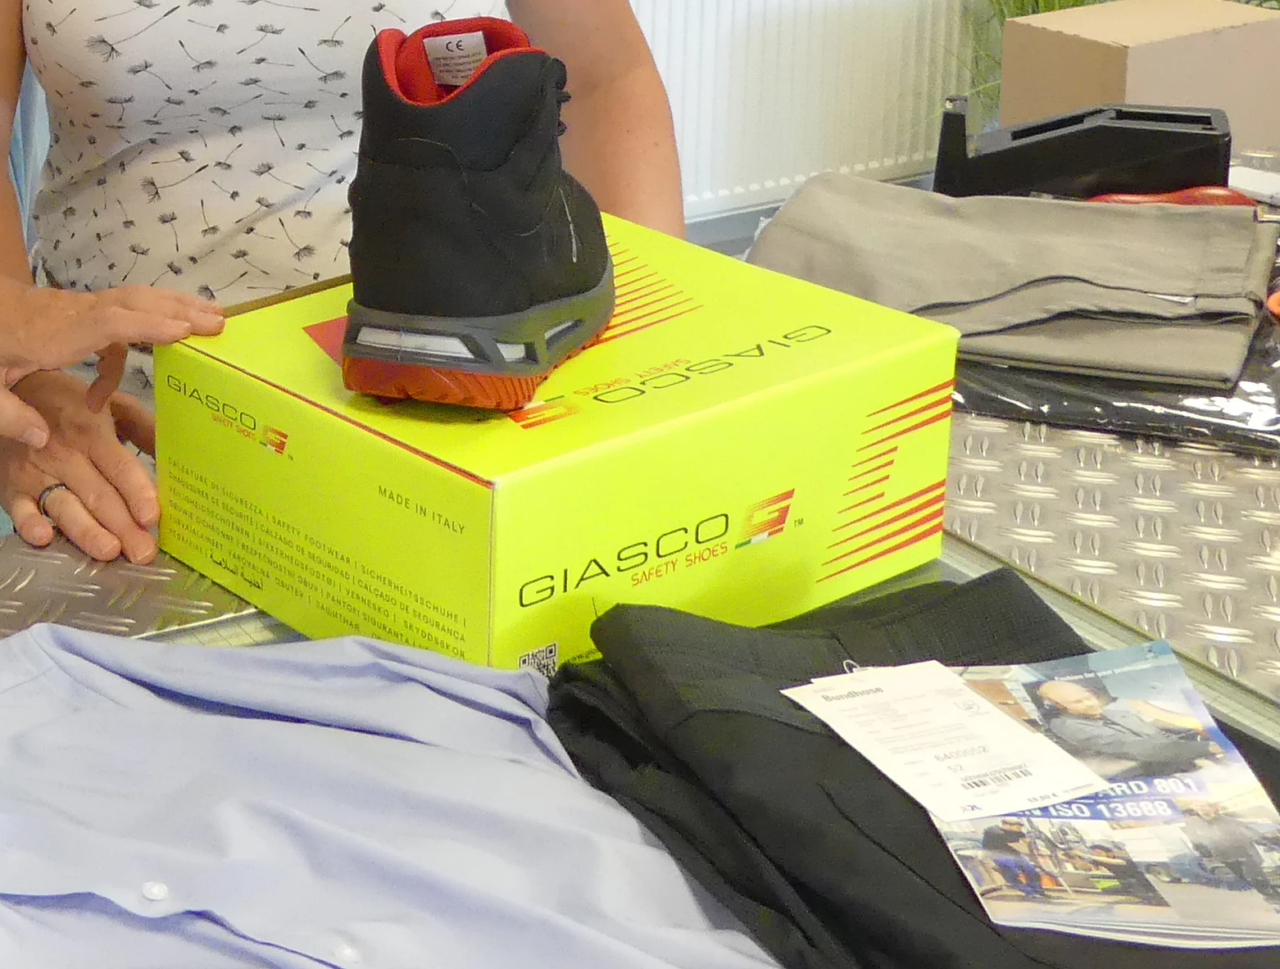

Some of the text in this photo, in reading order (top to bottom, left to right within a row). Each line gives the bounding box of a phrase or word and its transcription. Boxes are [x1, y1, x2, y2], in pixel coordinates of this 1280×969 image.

[573, 358, 691, 396] SAFETY SHOES
[592, 324, 832, 404] GIASCO
[167, 374, 257, 431] GIASCO
[377, 484, 466, 535] MADE IN ITALY
[272, 514, 300, 538] SAFETY
[304, 532, 350, 566] FOOTWEAR
[361, 563, 458, 625] SICHERHEITSSCHUHE
[519, 513, 730, 608] GIASCO
[631, 541, 729, 588] SAFETY SHOES
[399, 601, 409, 614] DE
[821, 685, 884, 702] Bundhose
[1049, 801, 1091, 818] ISO
[1097, 800, 1173, 819] 13688
